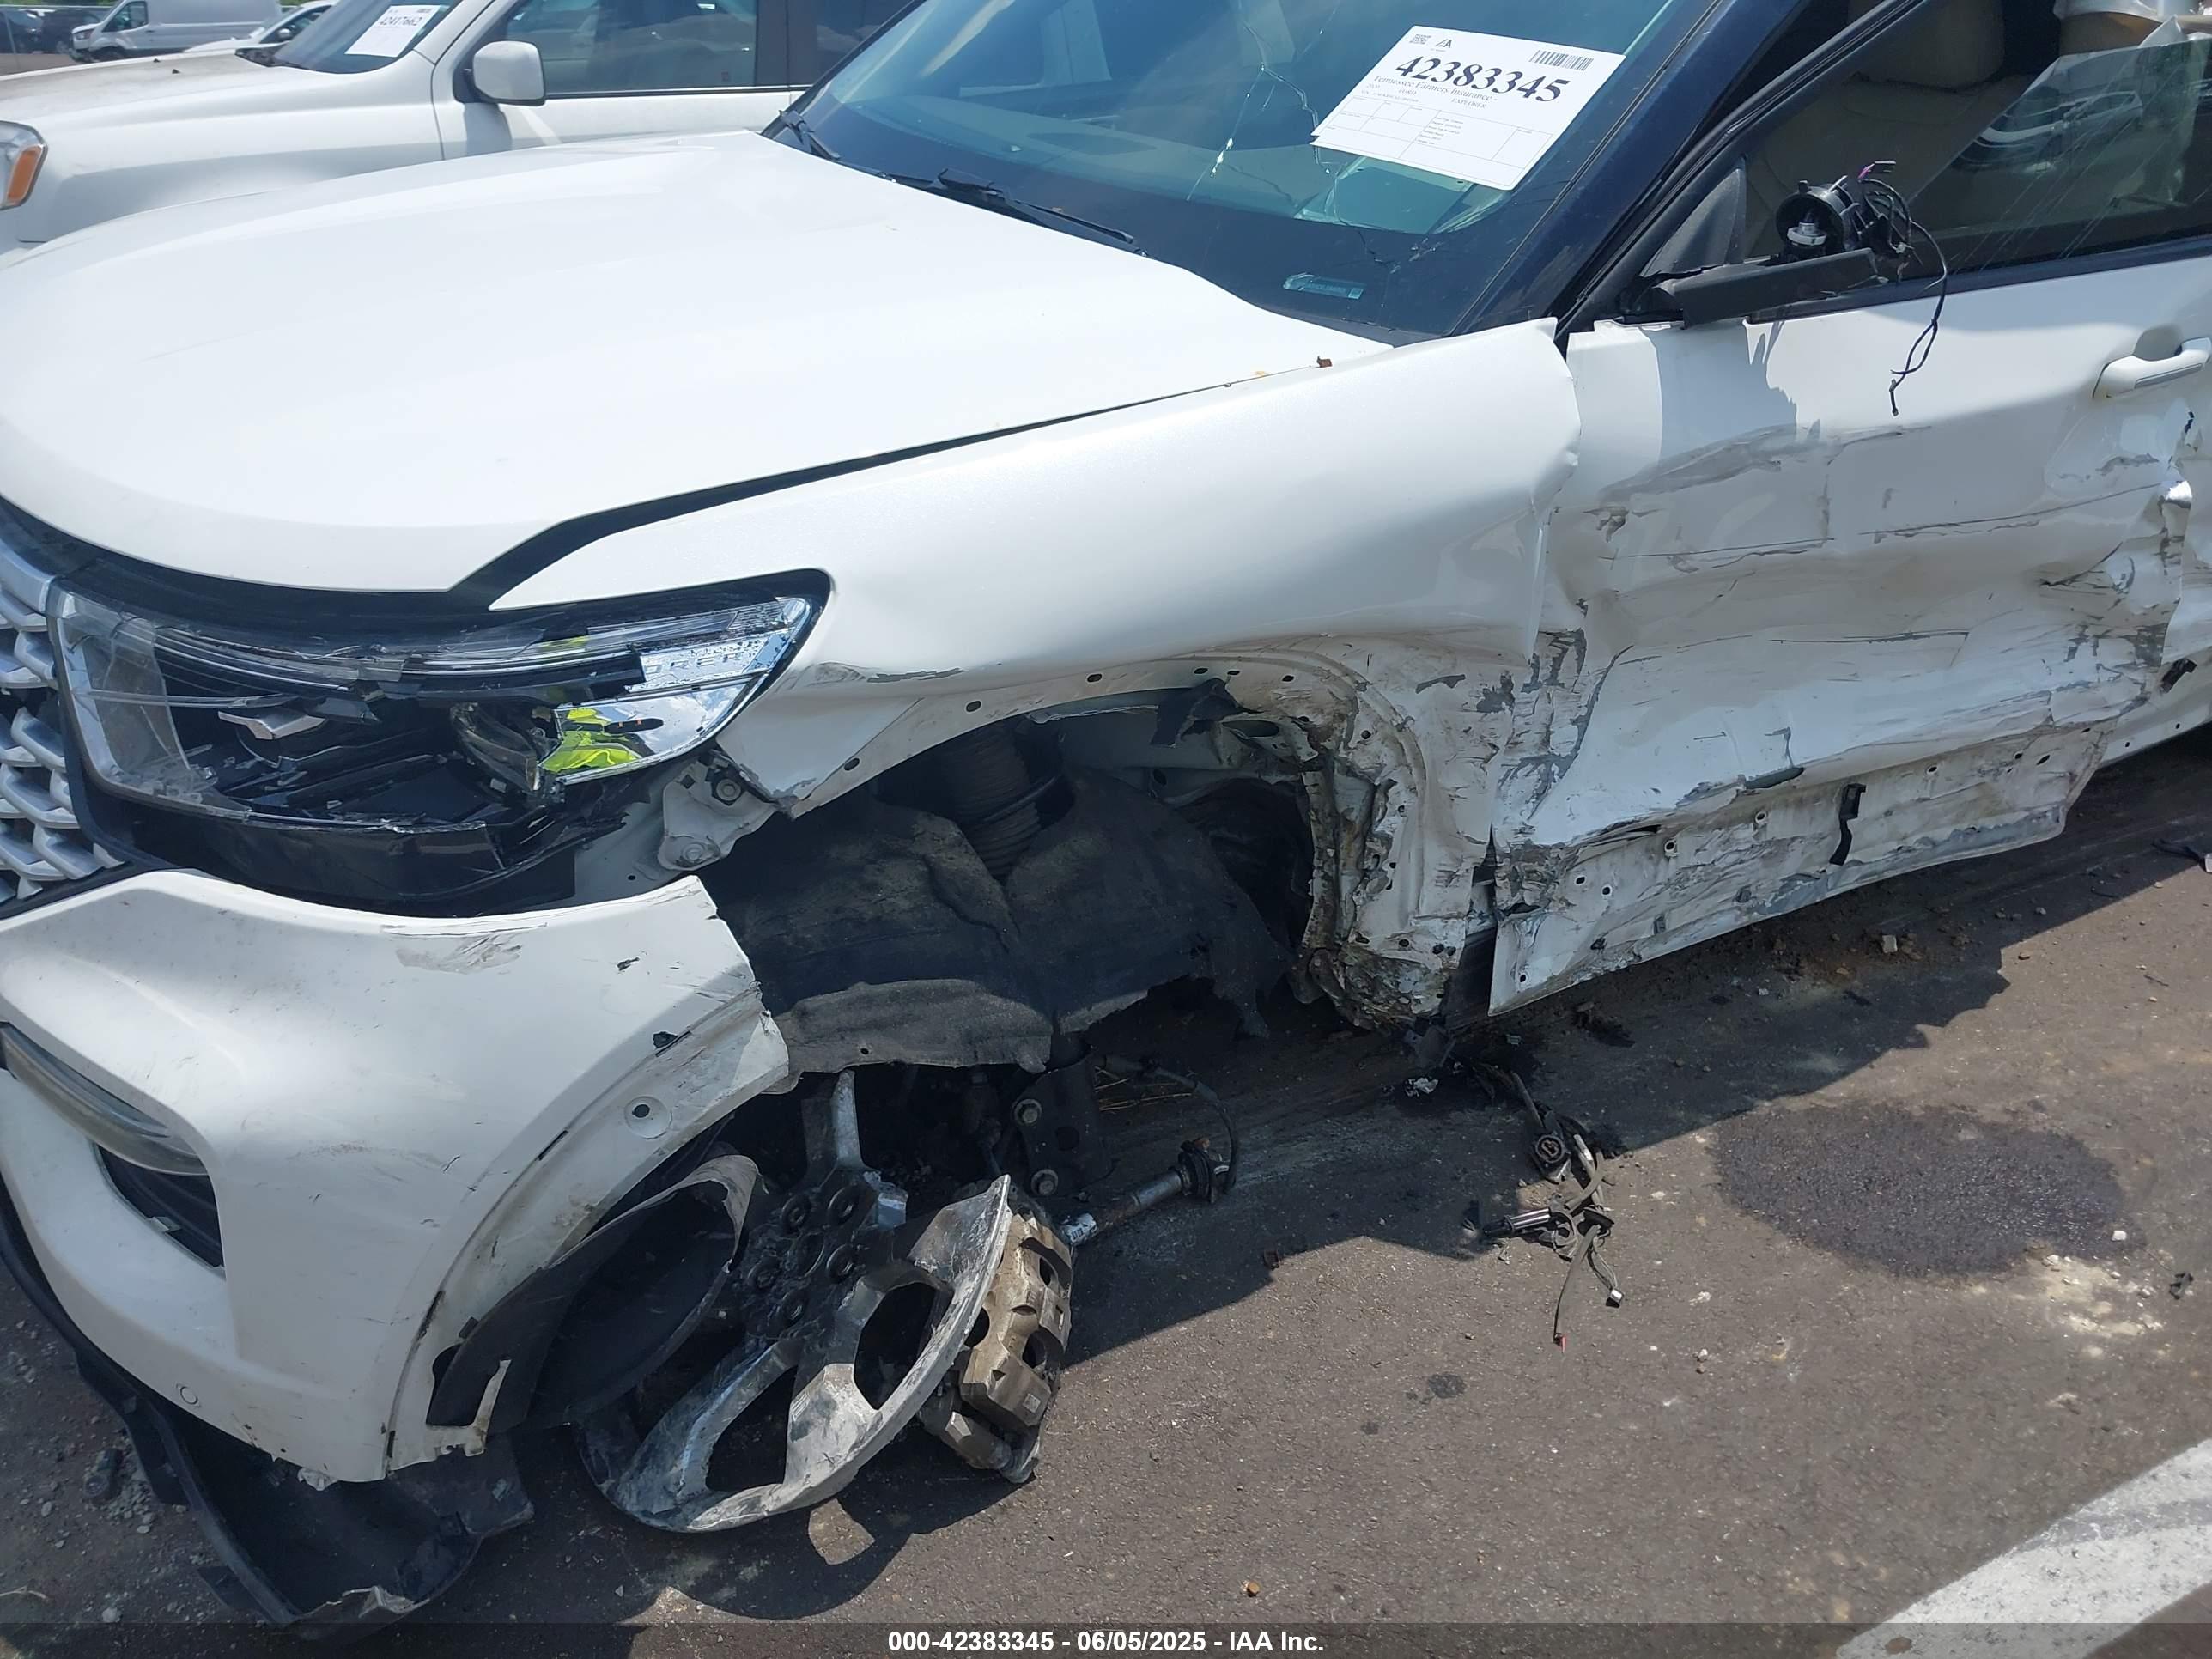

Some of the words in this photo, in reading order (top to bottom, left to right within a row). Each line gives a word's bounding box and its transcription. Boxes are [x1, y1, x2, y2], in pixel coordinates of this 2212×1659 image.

[1374, 75, 1415, 87] Tennessee
[1415, 82, 1449, 94] Farmers
[1450, 88, 1492, 101] Insurance
[1395, 55, 1571, 102] 42383345
